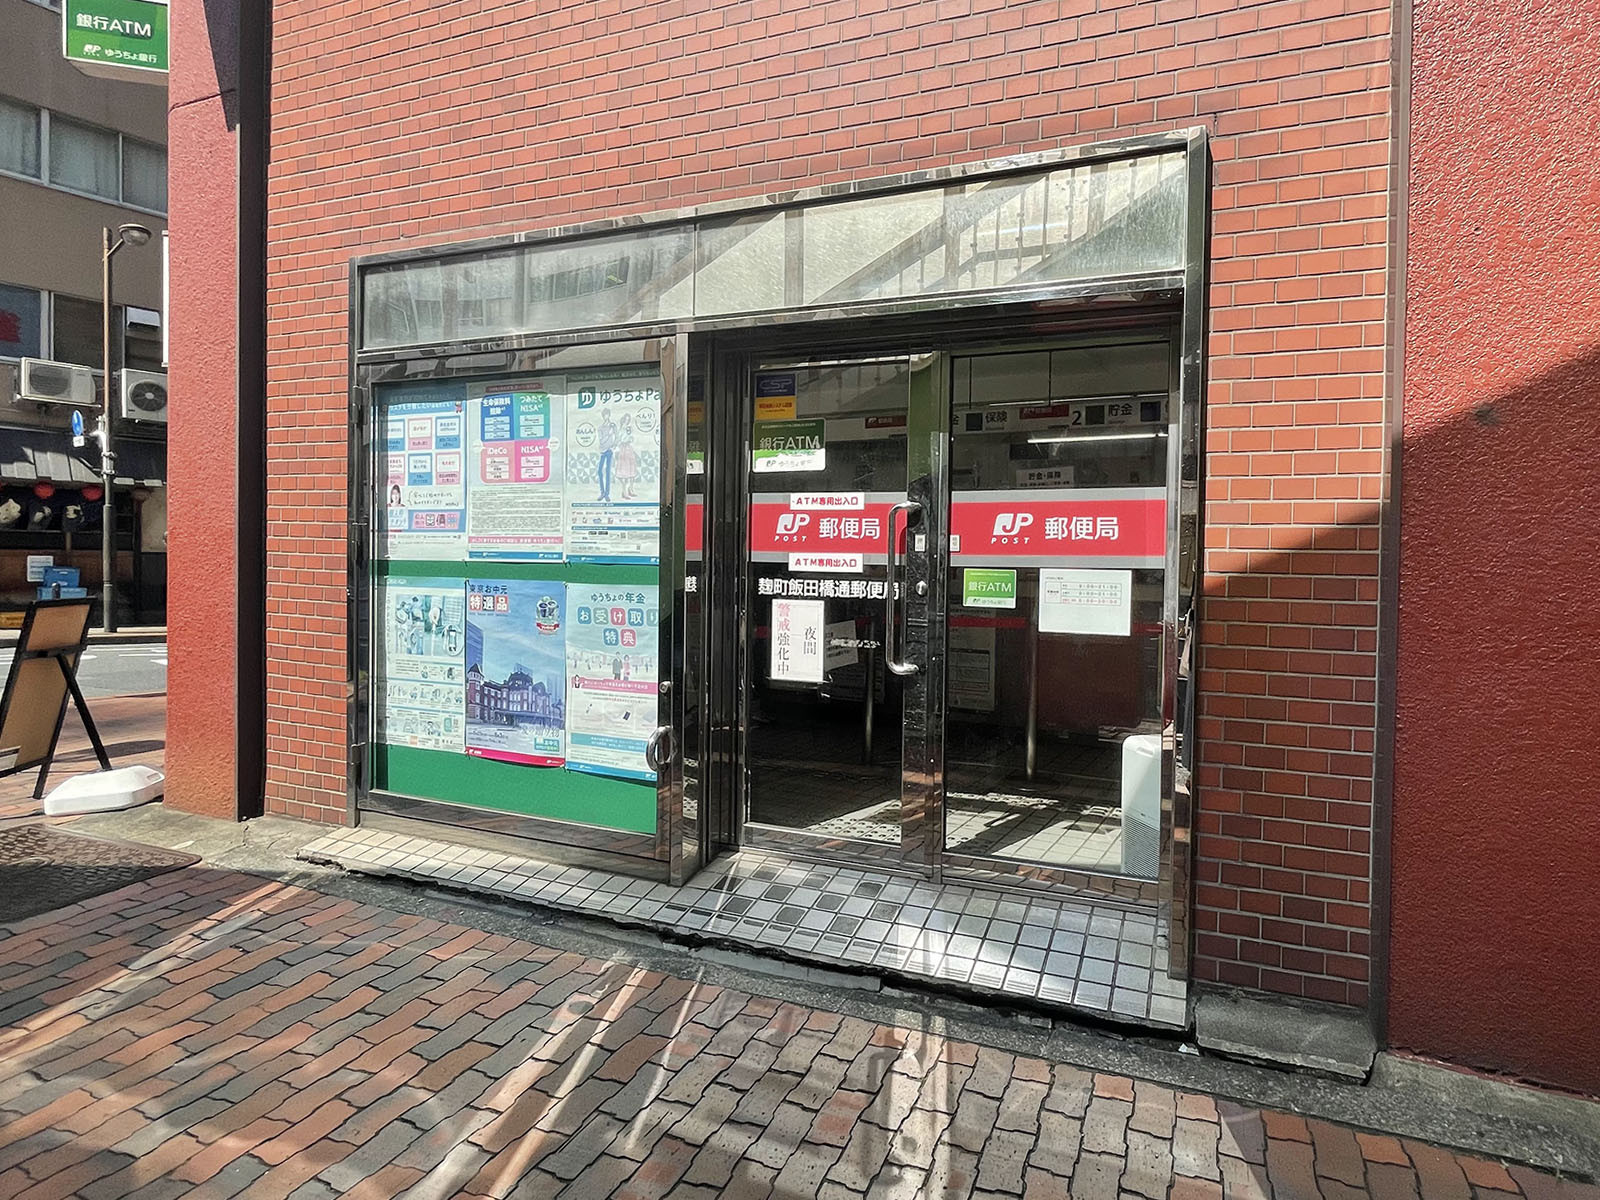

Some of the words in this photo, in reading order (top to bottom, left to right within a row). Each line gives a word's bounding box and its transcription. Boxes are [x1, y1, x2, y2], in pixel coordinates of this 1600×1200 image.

[76, 13, 151, 37] 銀行ATM
[105, 48, 157, 63] ゆうちょ銀行
[759, 379, 793, 389] CSP
[985, 410, 1008, 423] 保険
[1108, 403, 1133, 416] 貯金
[1071, 410, 1082, 426] 2
[521, 445, 540, 453] NISA
[760, 436, 821, 451] 銀行ATM
[796, 496, 858, 506] ATM専用出入口
[776, 513, 810, 534] JP
[819, 517, 880, 540] 郵便局
[992, 513, 1034, 536] JP
[1045, 516, 1119, 540] 郵便局
[774, 535, 807, 543] POST
[794, 557, 857, 568] ATM専用出入口
[469, 584, 508, 595] 東京お中元
[968, 581, 1012, 593] 銀行ATM
[469, 595, 508, 612] 特選品
[590, 592, 646, 604] ゆうちょの年金
[579, 609, 658, 624] お受け取り
[605, 630, 636, 646] 特典
[803, 626, 816, 655] 夜間
